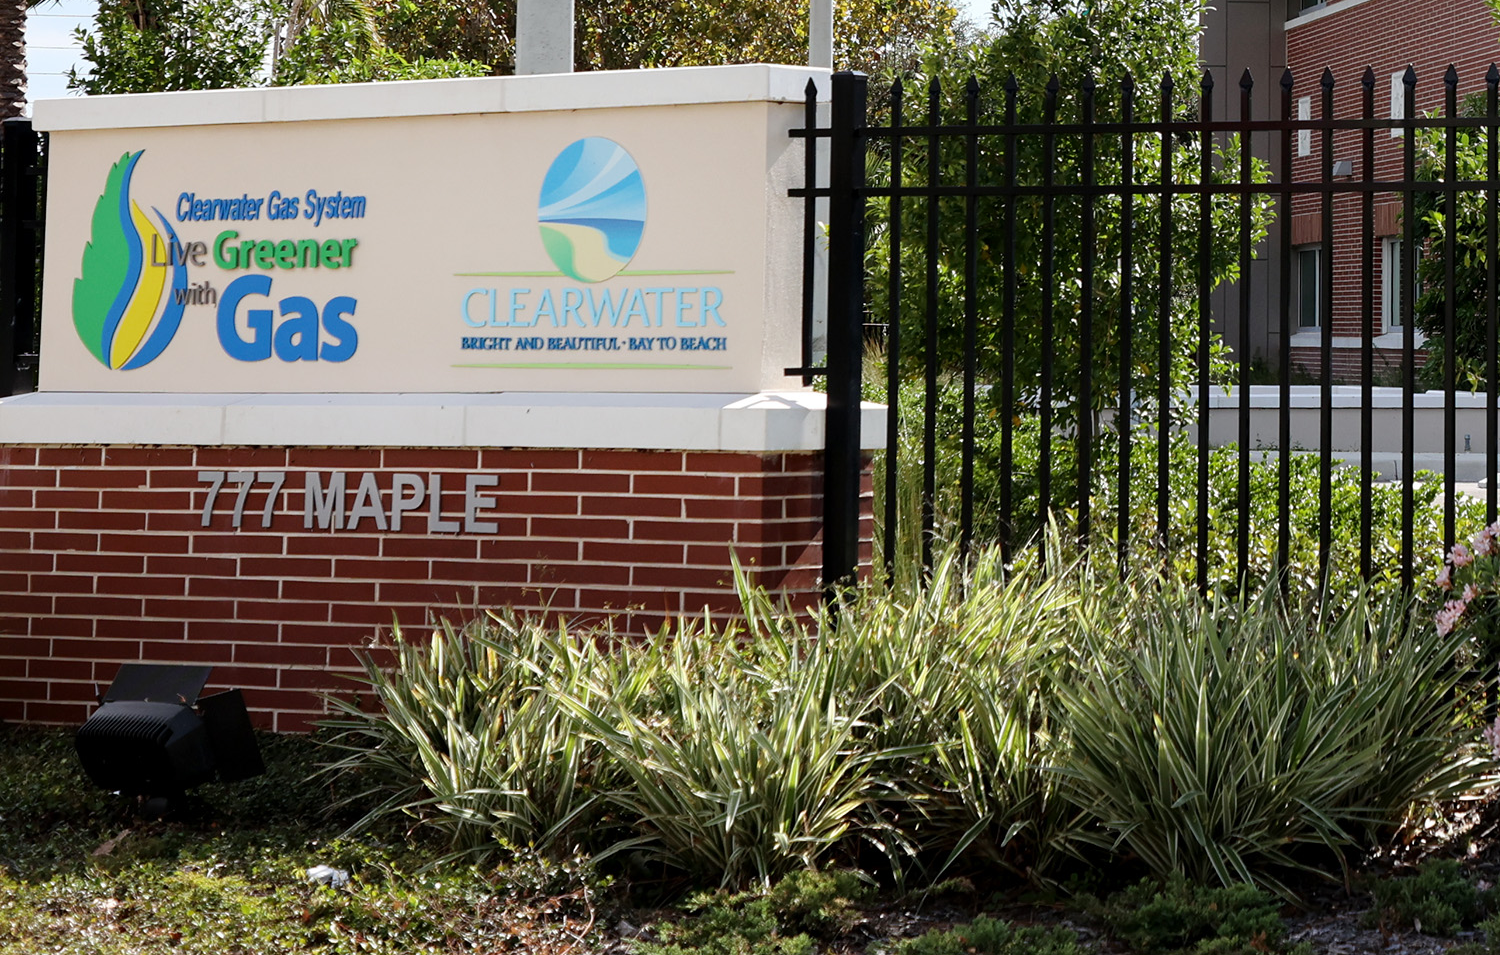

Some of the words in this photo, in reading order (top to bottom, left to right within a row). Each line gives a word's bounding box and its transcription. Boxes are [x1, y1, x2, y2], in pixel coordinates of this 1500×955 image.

[176, 192, 264, 222] Clearwater
[267, 190, 300, 220] Gas
[303, 189, 367, 227] System
[151, 233, 208, 267] Live
[213, 230, 359, 270] Greener
[174, 281, 217, 307] with
[216, 274, 359, 363] Gas
[460, 286, 727, 328] CLEARWATER
[461, 337, 512, 350] BRIGHT
[515, 337, 544, 350] AND
[547, 336, 620, 351] BEAUTIFUL
[628, 337, 655, 350] BAY
[657, 337, 677, 350] TO
[680, 337, 727, 351] BEACH
[198, 471, 286, 528] 777
[303, 471, 499, 533] MAPLE
